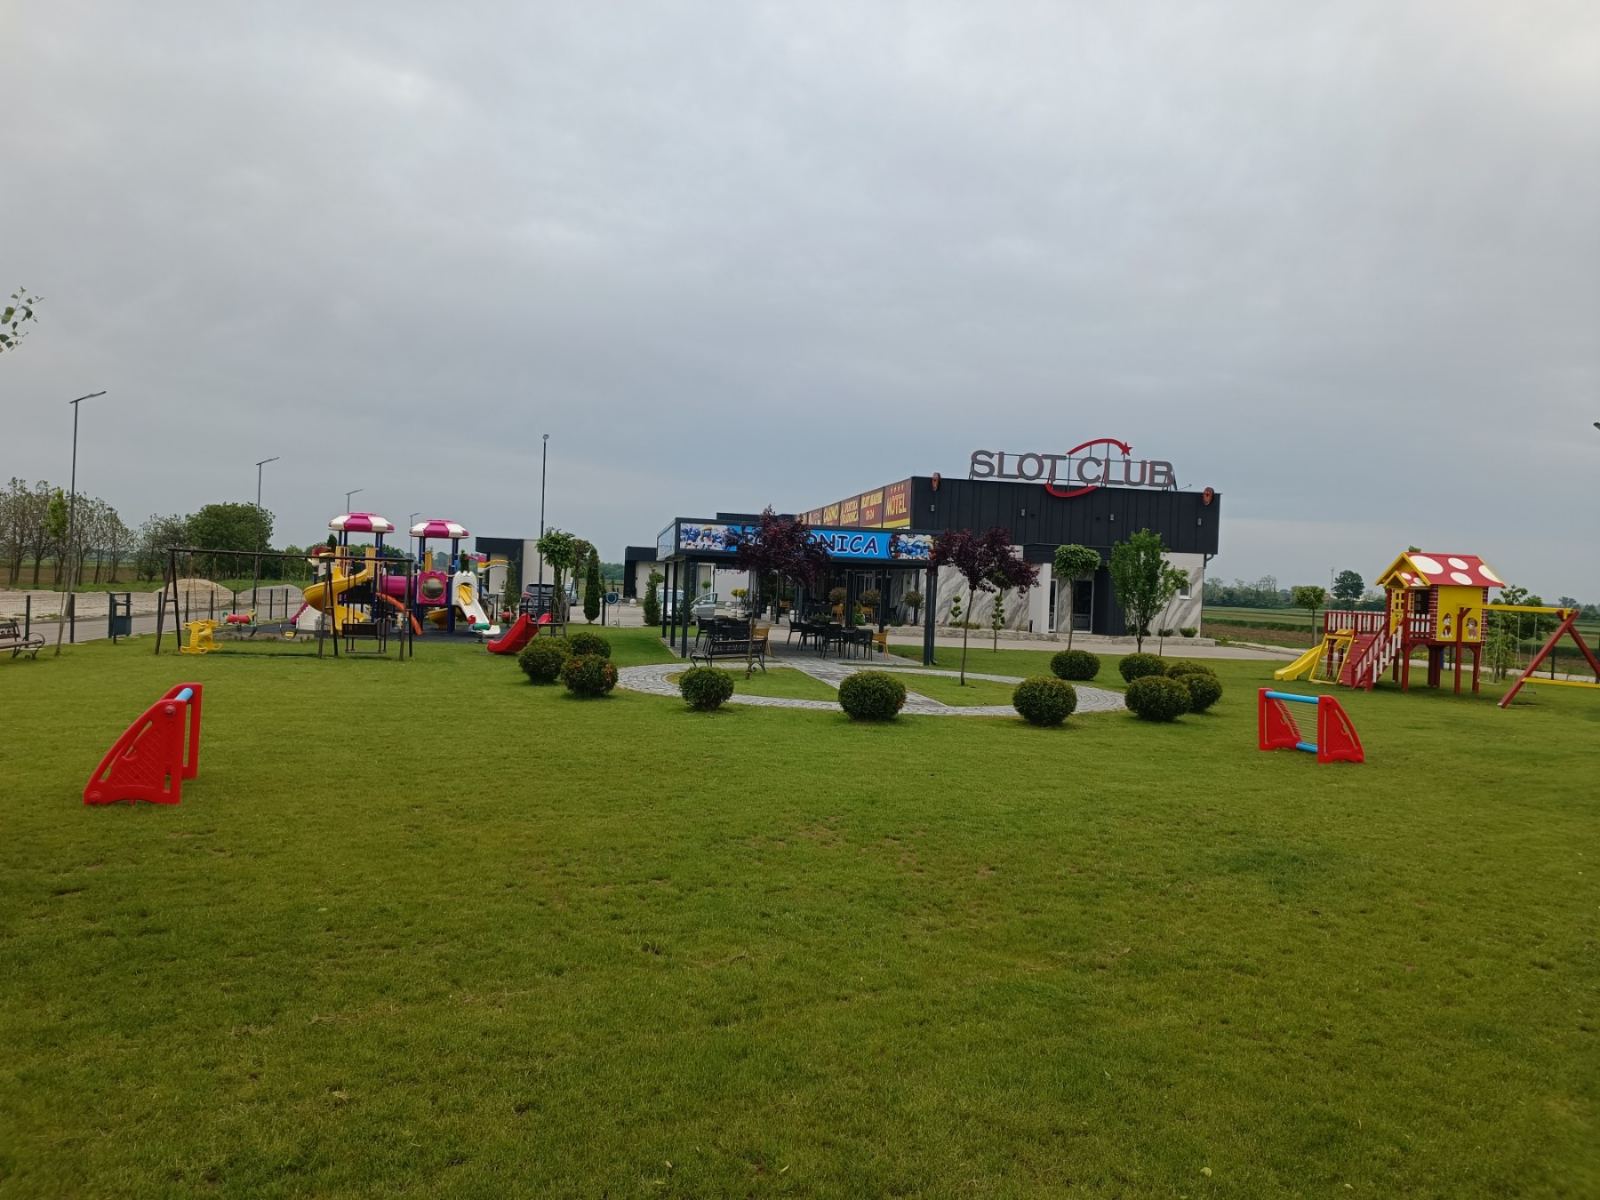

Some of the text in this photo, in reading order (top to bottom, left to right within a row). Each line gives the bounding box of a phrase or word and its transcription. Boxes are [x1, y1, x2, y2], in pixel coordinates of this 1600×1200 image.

[971, 450, 1174, 487] SLOT CLUB
[886, 493, 907, 516] MOTEL
